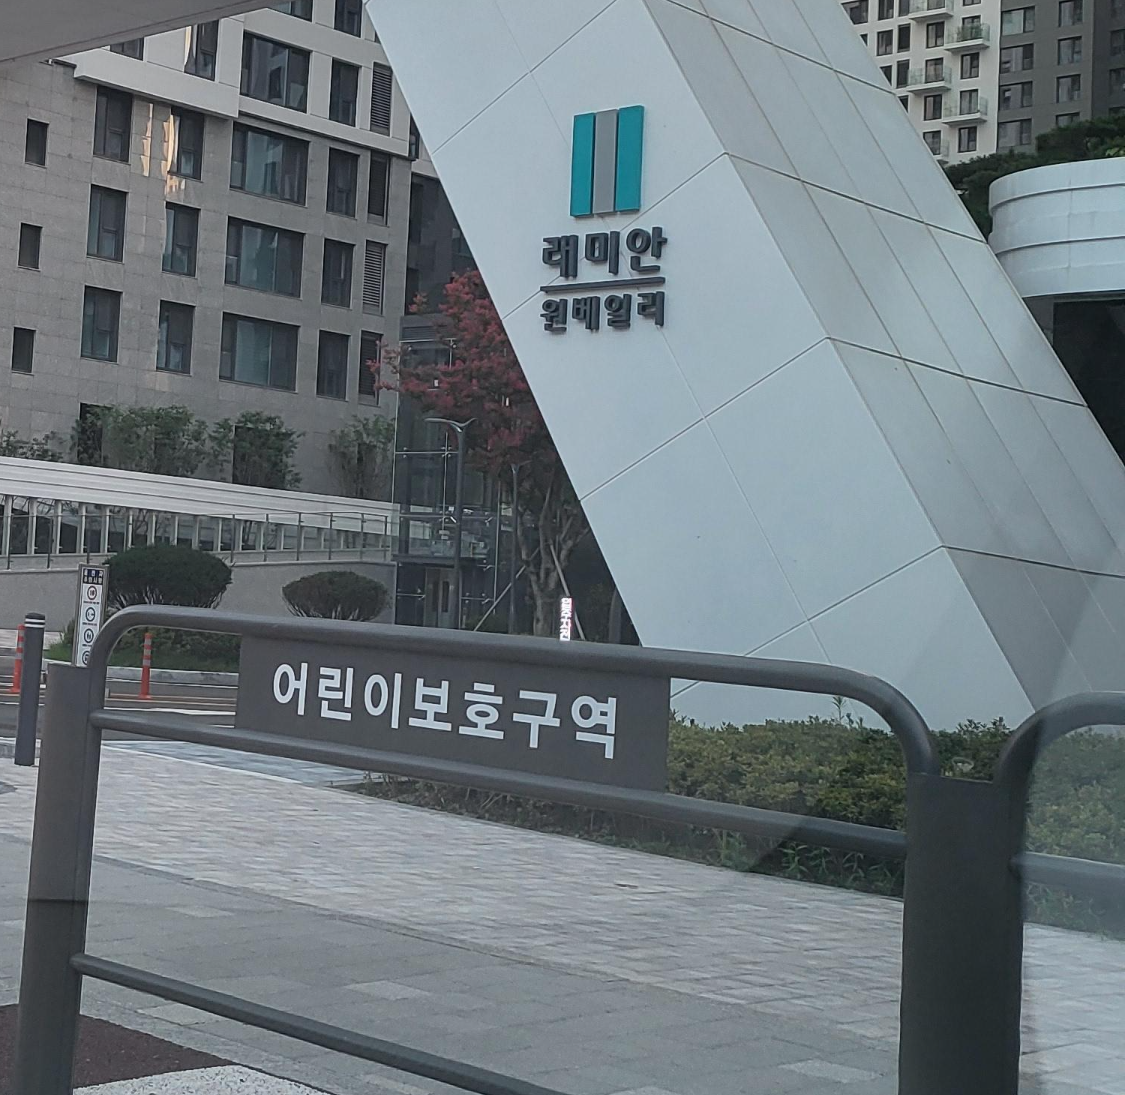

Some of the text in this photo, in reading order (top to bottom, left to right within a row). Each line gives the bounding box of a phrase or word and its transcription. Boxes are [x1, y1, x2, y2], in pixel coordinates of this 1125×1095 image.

[542, 226, 668, 278] 래미안
[540, 291, 665, 332] 원베일리
[272, 662, 617, 760] 어린이보호구역
